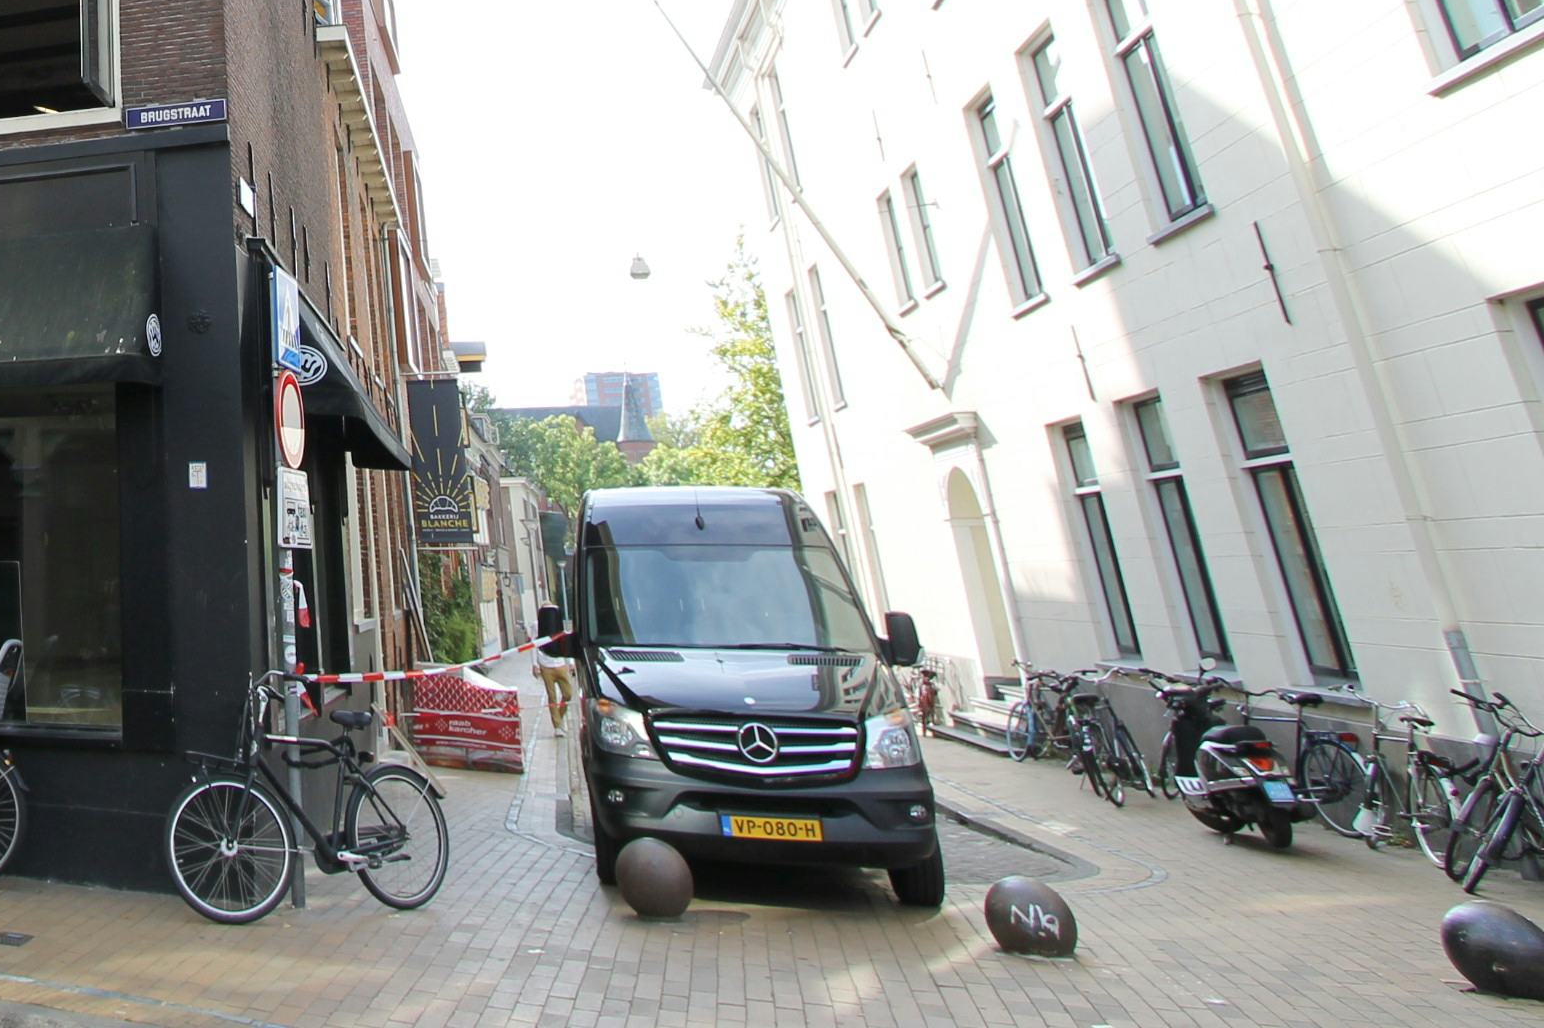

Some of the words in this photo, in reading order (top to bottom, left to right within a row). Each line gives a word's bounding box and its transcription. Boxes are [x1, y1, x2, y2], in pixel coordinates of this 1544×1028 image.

[140, 105, 212, 124] BRUGSTRAAT
[421, 519, 469, 528] BLANCHE
[734, 819, 817, 838] VP-080-H
